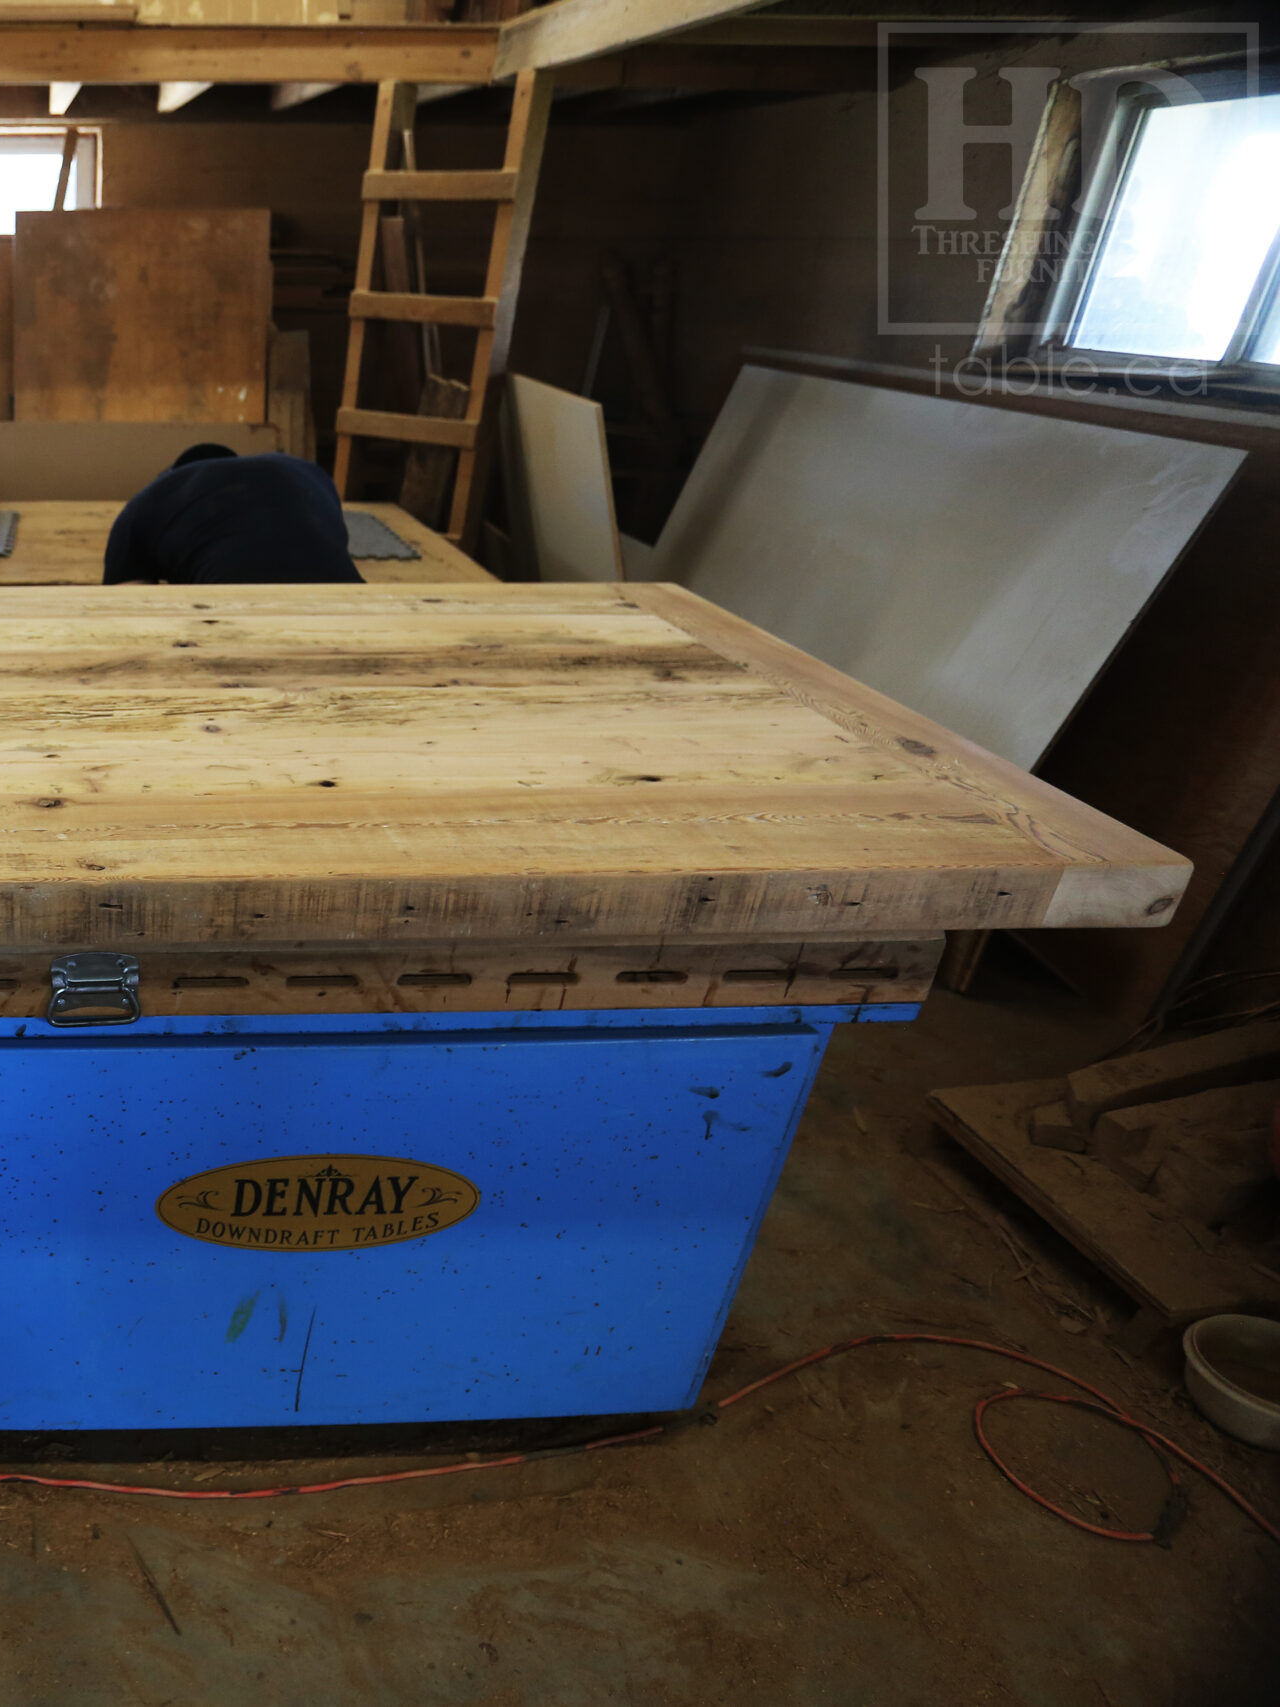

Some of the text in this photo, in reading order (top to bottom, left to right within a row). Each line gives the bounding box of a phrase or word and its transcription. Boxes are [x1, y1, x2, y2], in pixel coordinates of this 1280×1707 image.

[229, 1175, 420, 1218] DENRAY
[195, 1211, 441, 1246] DOWNDRAFT TABLES
